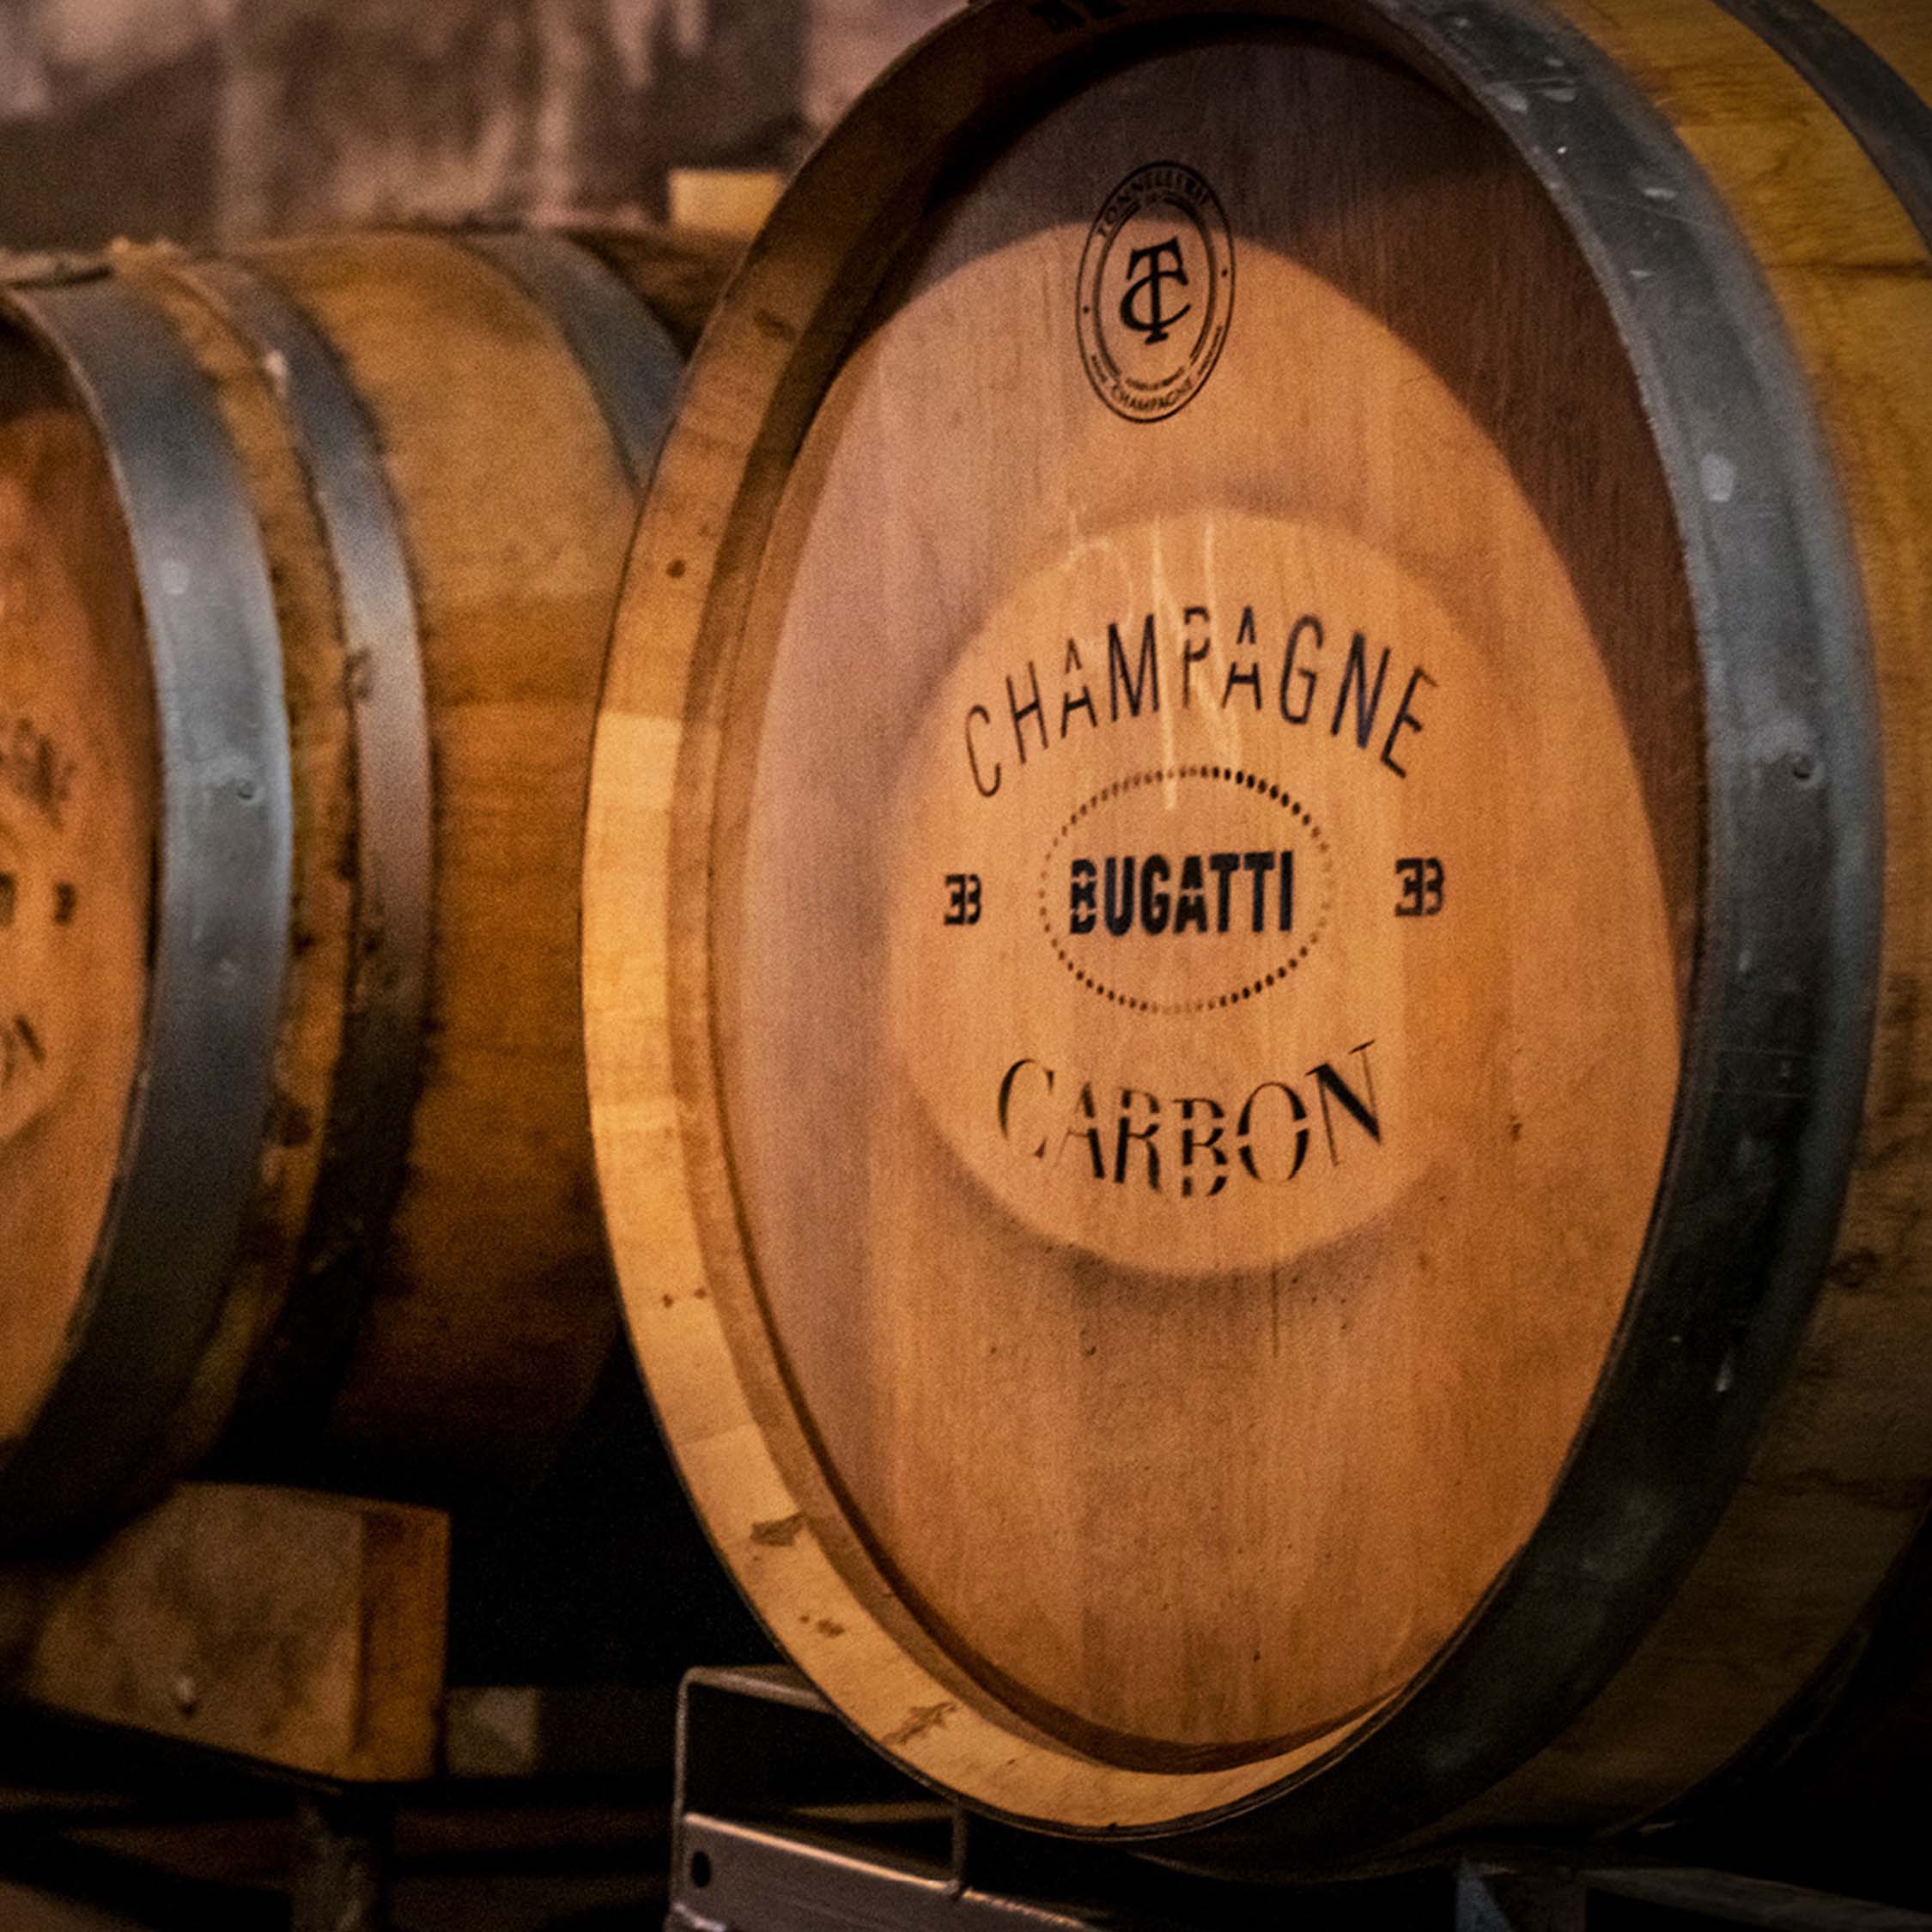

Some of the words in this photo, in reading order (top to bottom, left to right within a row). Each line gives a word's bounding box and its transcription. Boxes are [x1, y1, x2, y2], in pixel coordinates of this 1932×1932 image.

[1110, 377, 1194, 413] CHAMPAGNE
[965, 605, 1438, 799] CHAMPAGNE
[1069, 850, 1292, 935] BUGATTI
[997, 1040, 1382, 1198] CARBON
